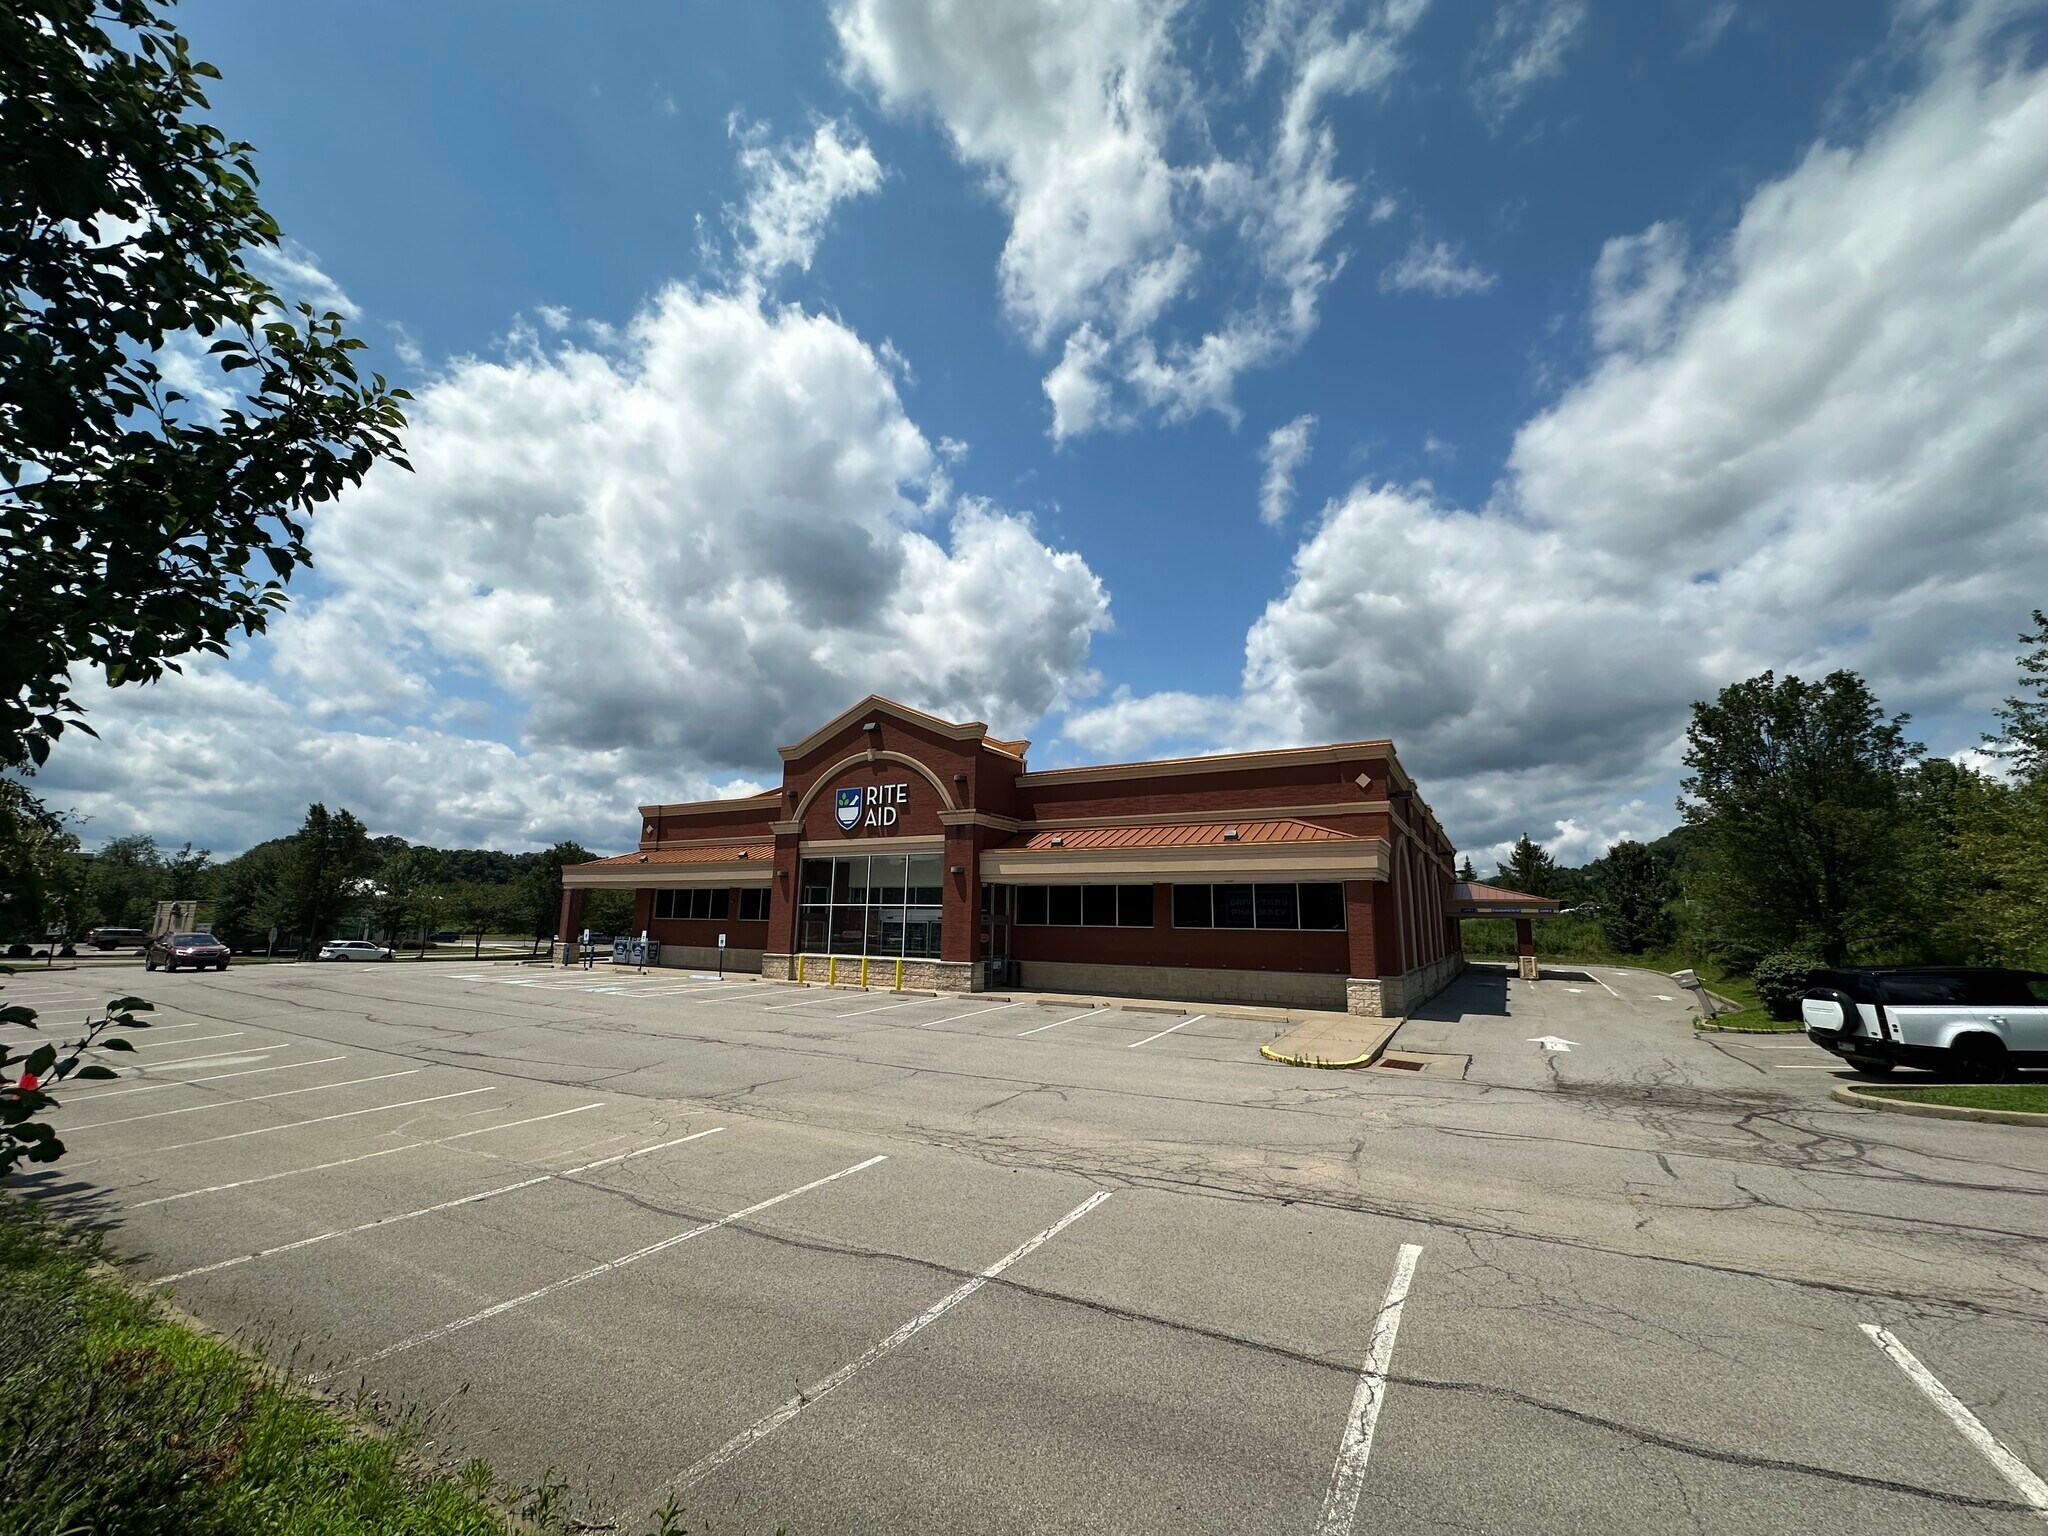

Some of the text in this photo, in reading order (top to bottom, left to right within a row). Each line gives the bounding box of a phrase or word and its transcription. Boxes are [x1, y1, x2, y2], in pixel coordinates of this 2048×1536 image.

[867, 783, 908, 805] RITE
[864, 806, 897, 827] AID
[1230, 898, 1288, 906] DRIV-THRU
[1231, 908, 1287, 916] PHAMACY
